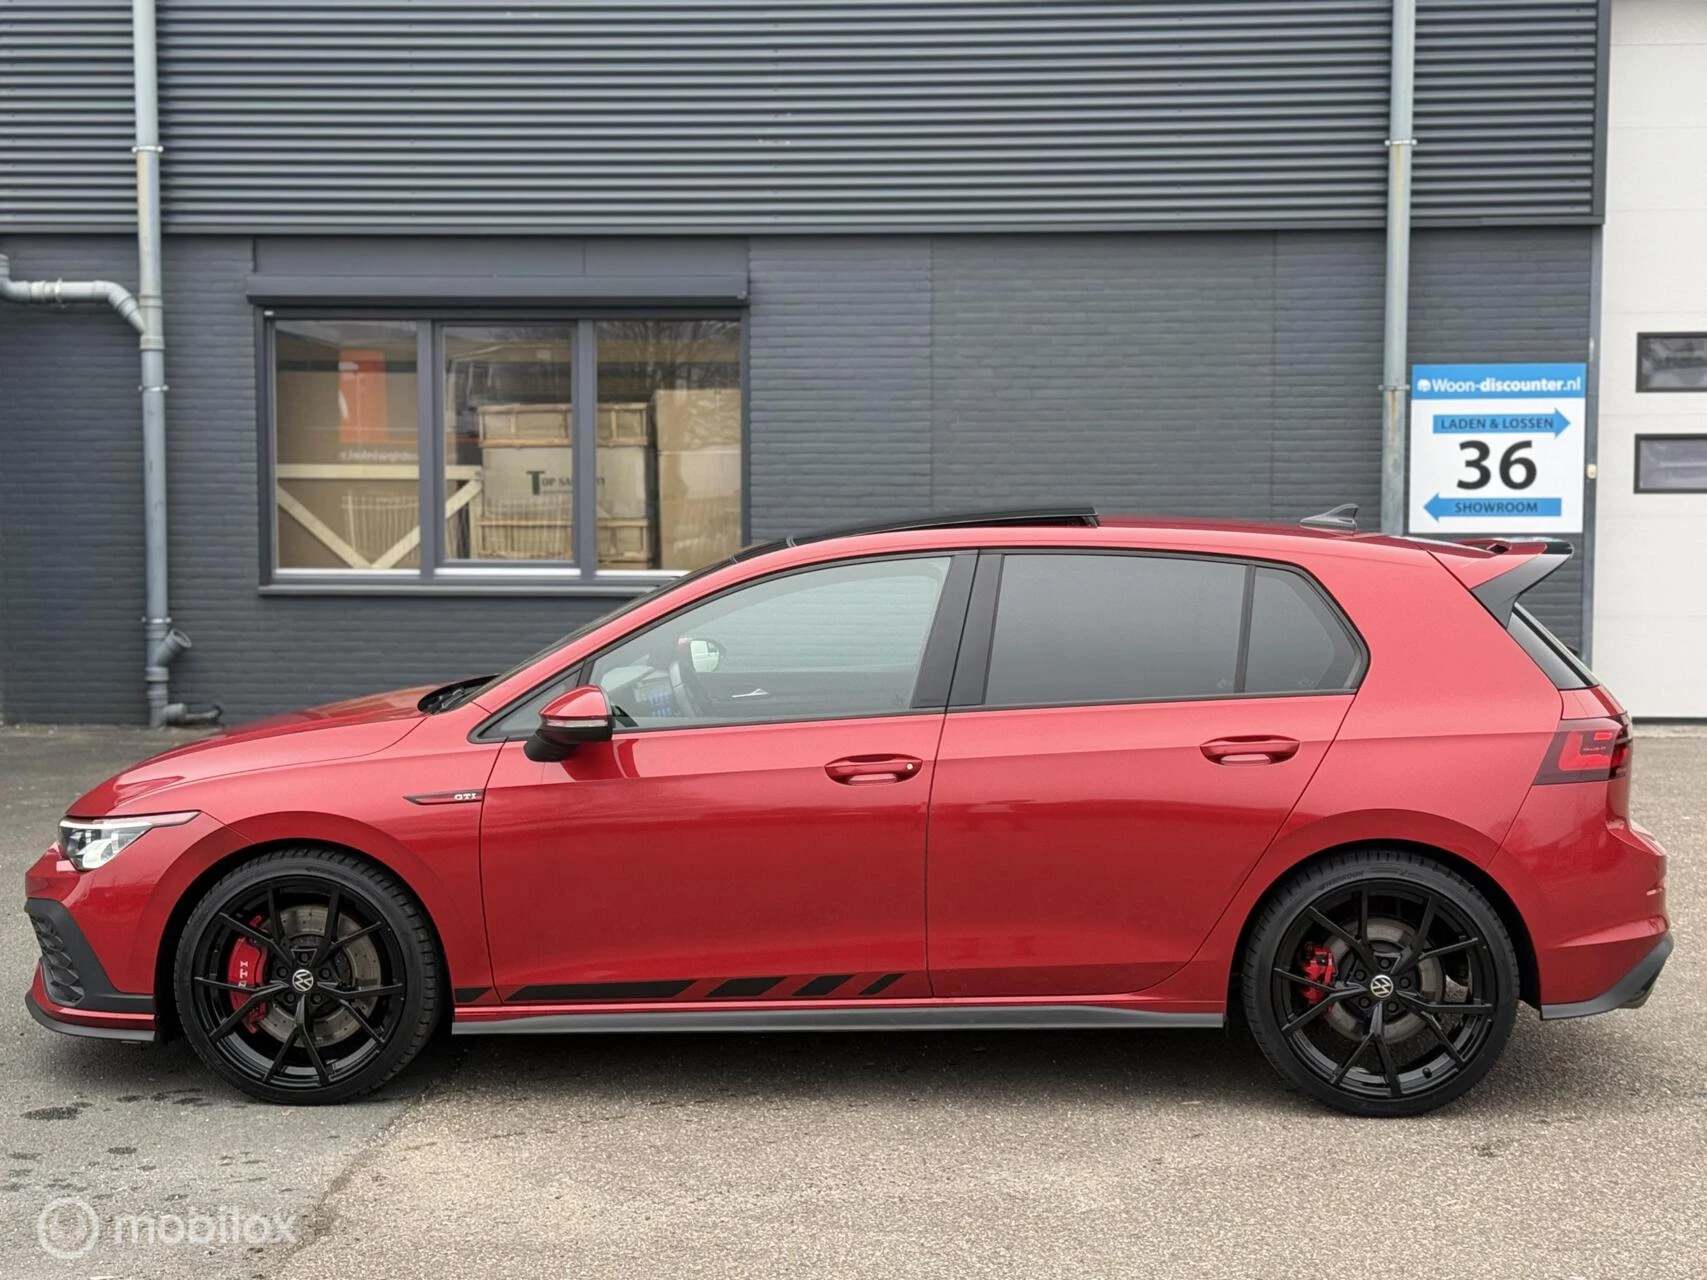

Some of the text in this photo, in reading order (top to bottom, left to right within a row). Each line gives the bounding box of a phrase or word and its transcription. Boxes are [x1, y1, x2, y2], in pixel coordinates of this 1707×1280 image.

[1432, 377, 1581, 392] Woon-discounter.nl
[1441, 417, 1554, 430] LADEN & LOSSEN
[1456, 440, 1537, 490] 36
[1455, 502, 1538, 513] SHOWROOM
[454, 793, 477, 801] GTI
